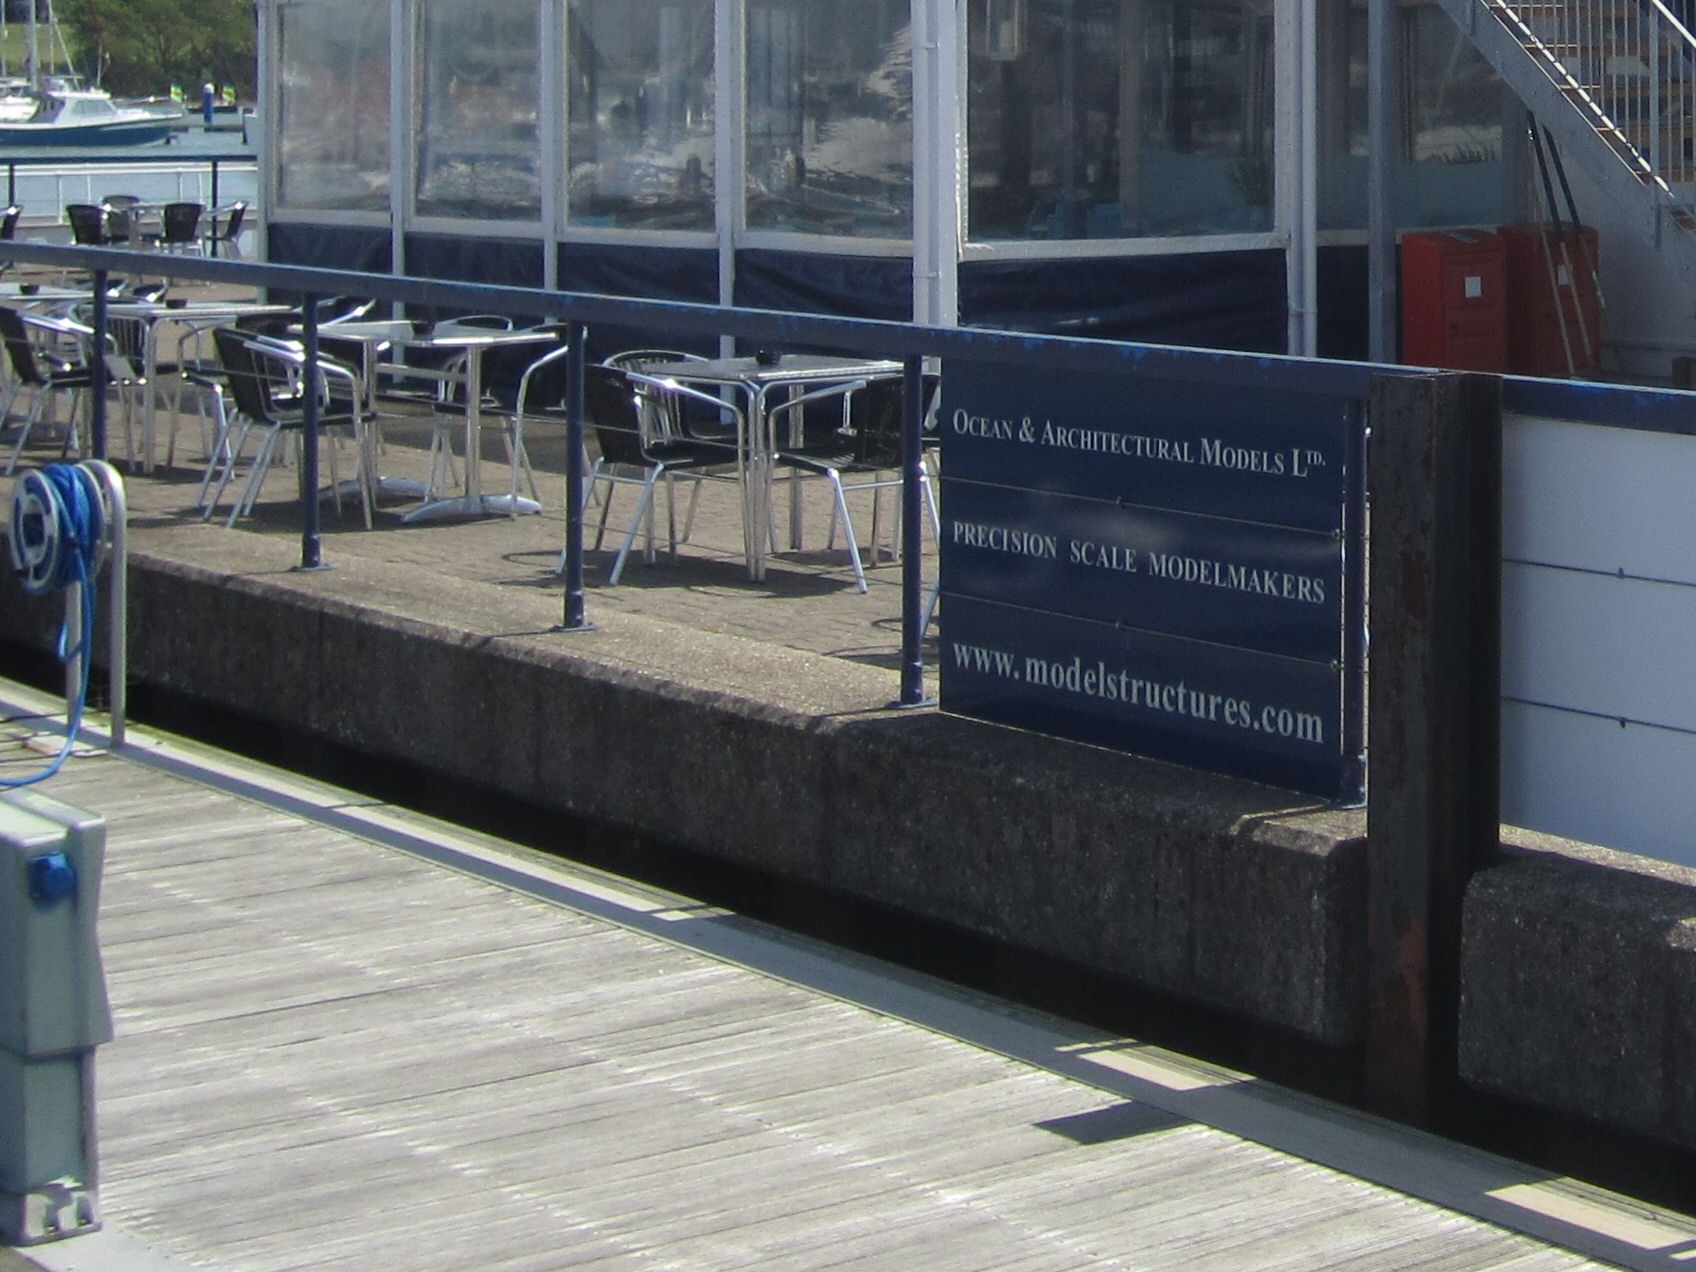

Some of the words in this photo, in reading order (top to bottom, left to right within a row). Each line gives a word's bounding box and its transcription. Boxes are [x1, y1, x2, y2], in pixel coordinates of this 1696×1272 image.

[1019, 416, 1035, 444] &
[953, 520, 1058, 559] PRECISION
[1070, 539, 1137, 573] SCALE
[1149, 552, 1325, 604] MODELMAKERS
